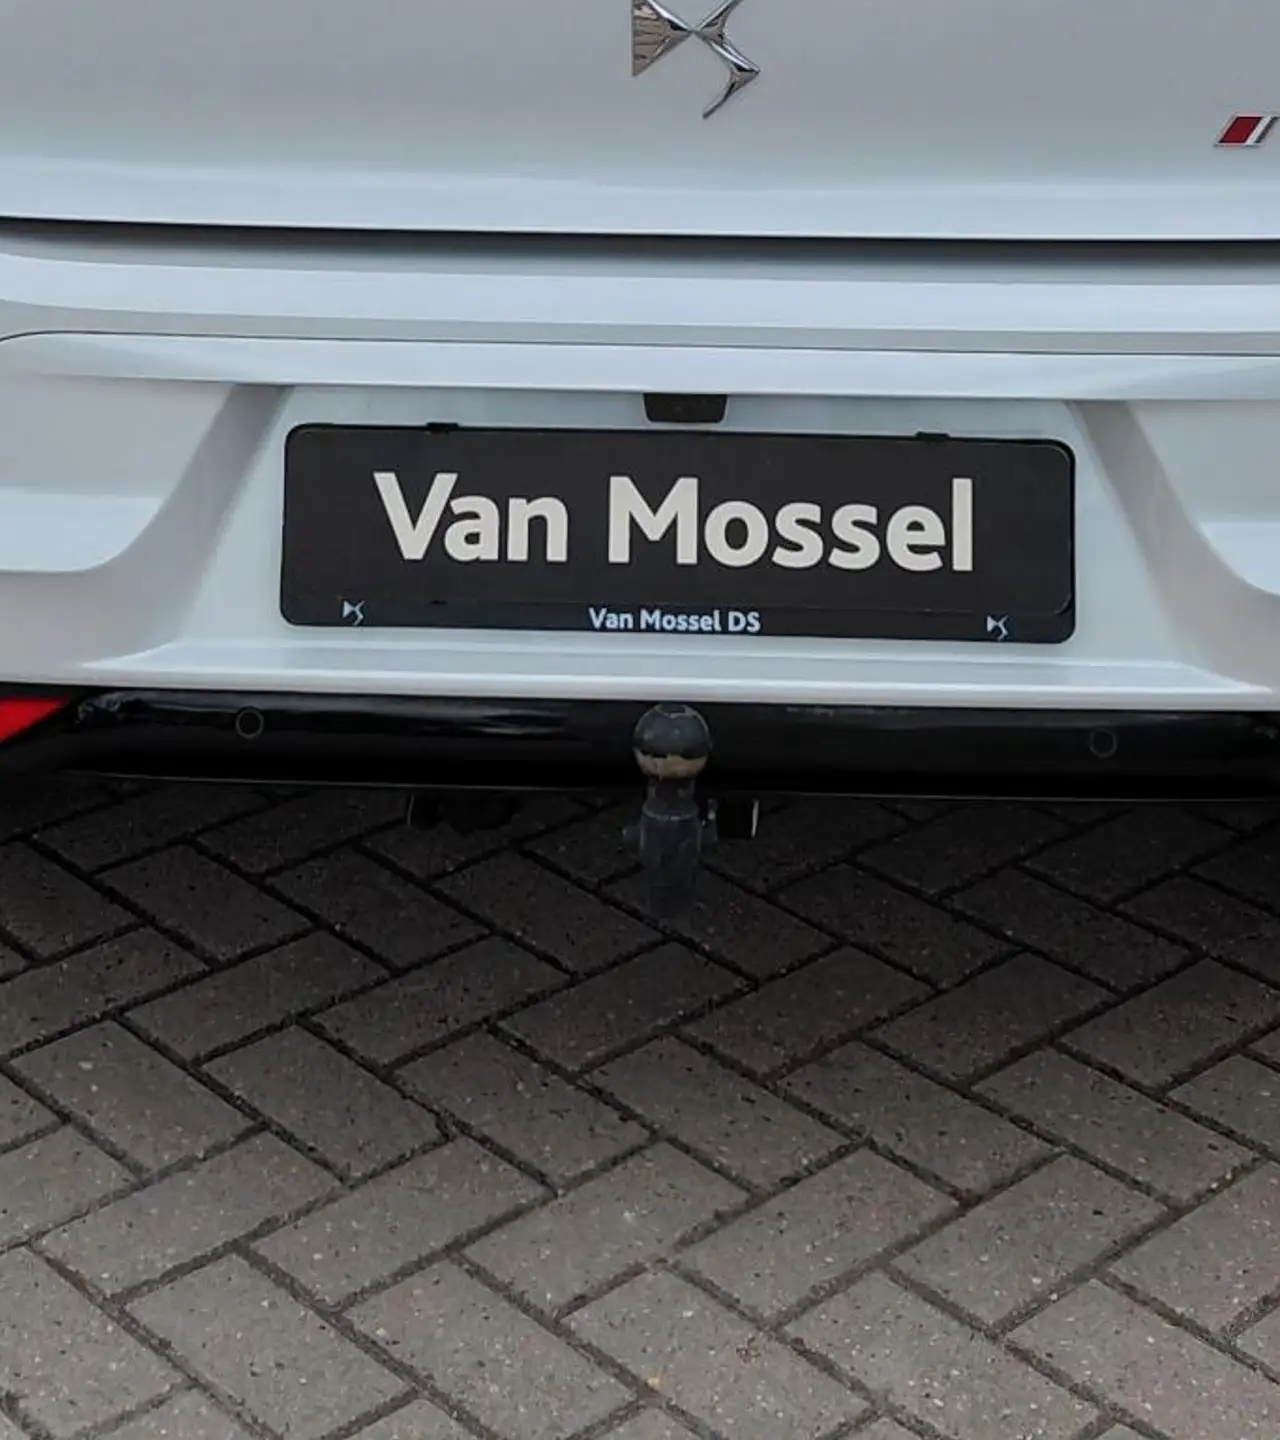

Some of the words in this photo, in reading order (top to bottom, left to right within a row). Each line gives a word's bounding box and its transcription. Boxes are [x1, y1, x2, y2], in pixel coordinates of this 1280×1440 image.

[373, 472, 568, 562] Van
[608, 476, 973, 572] Mossel
[588, 607, 634, 630] Van
[640, 609, 722, 632] Mossel
[727, 611, 761, 633] DS
